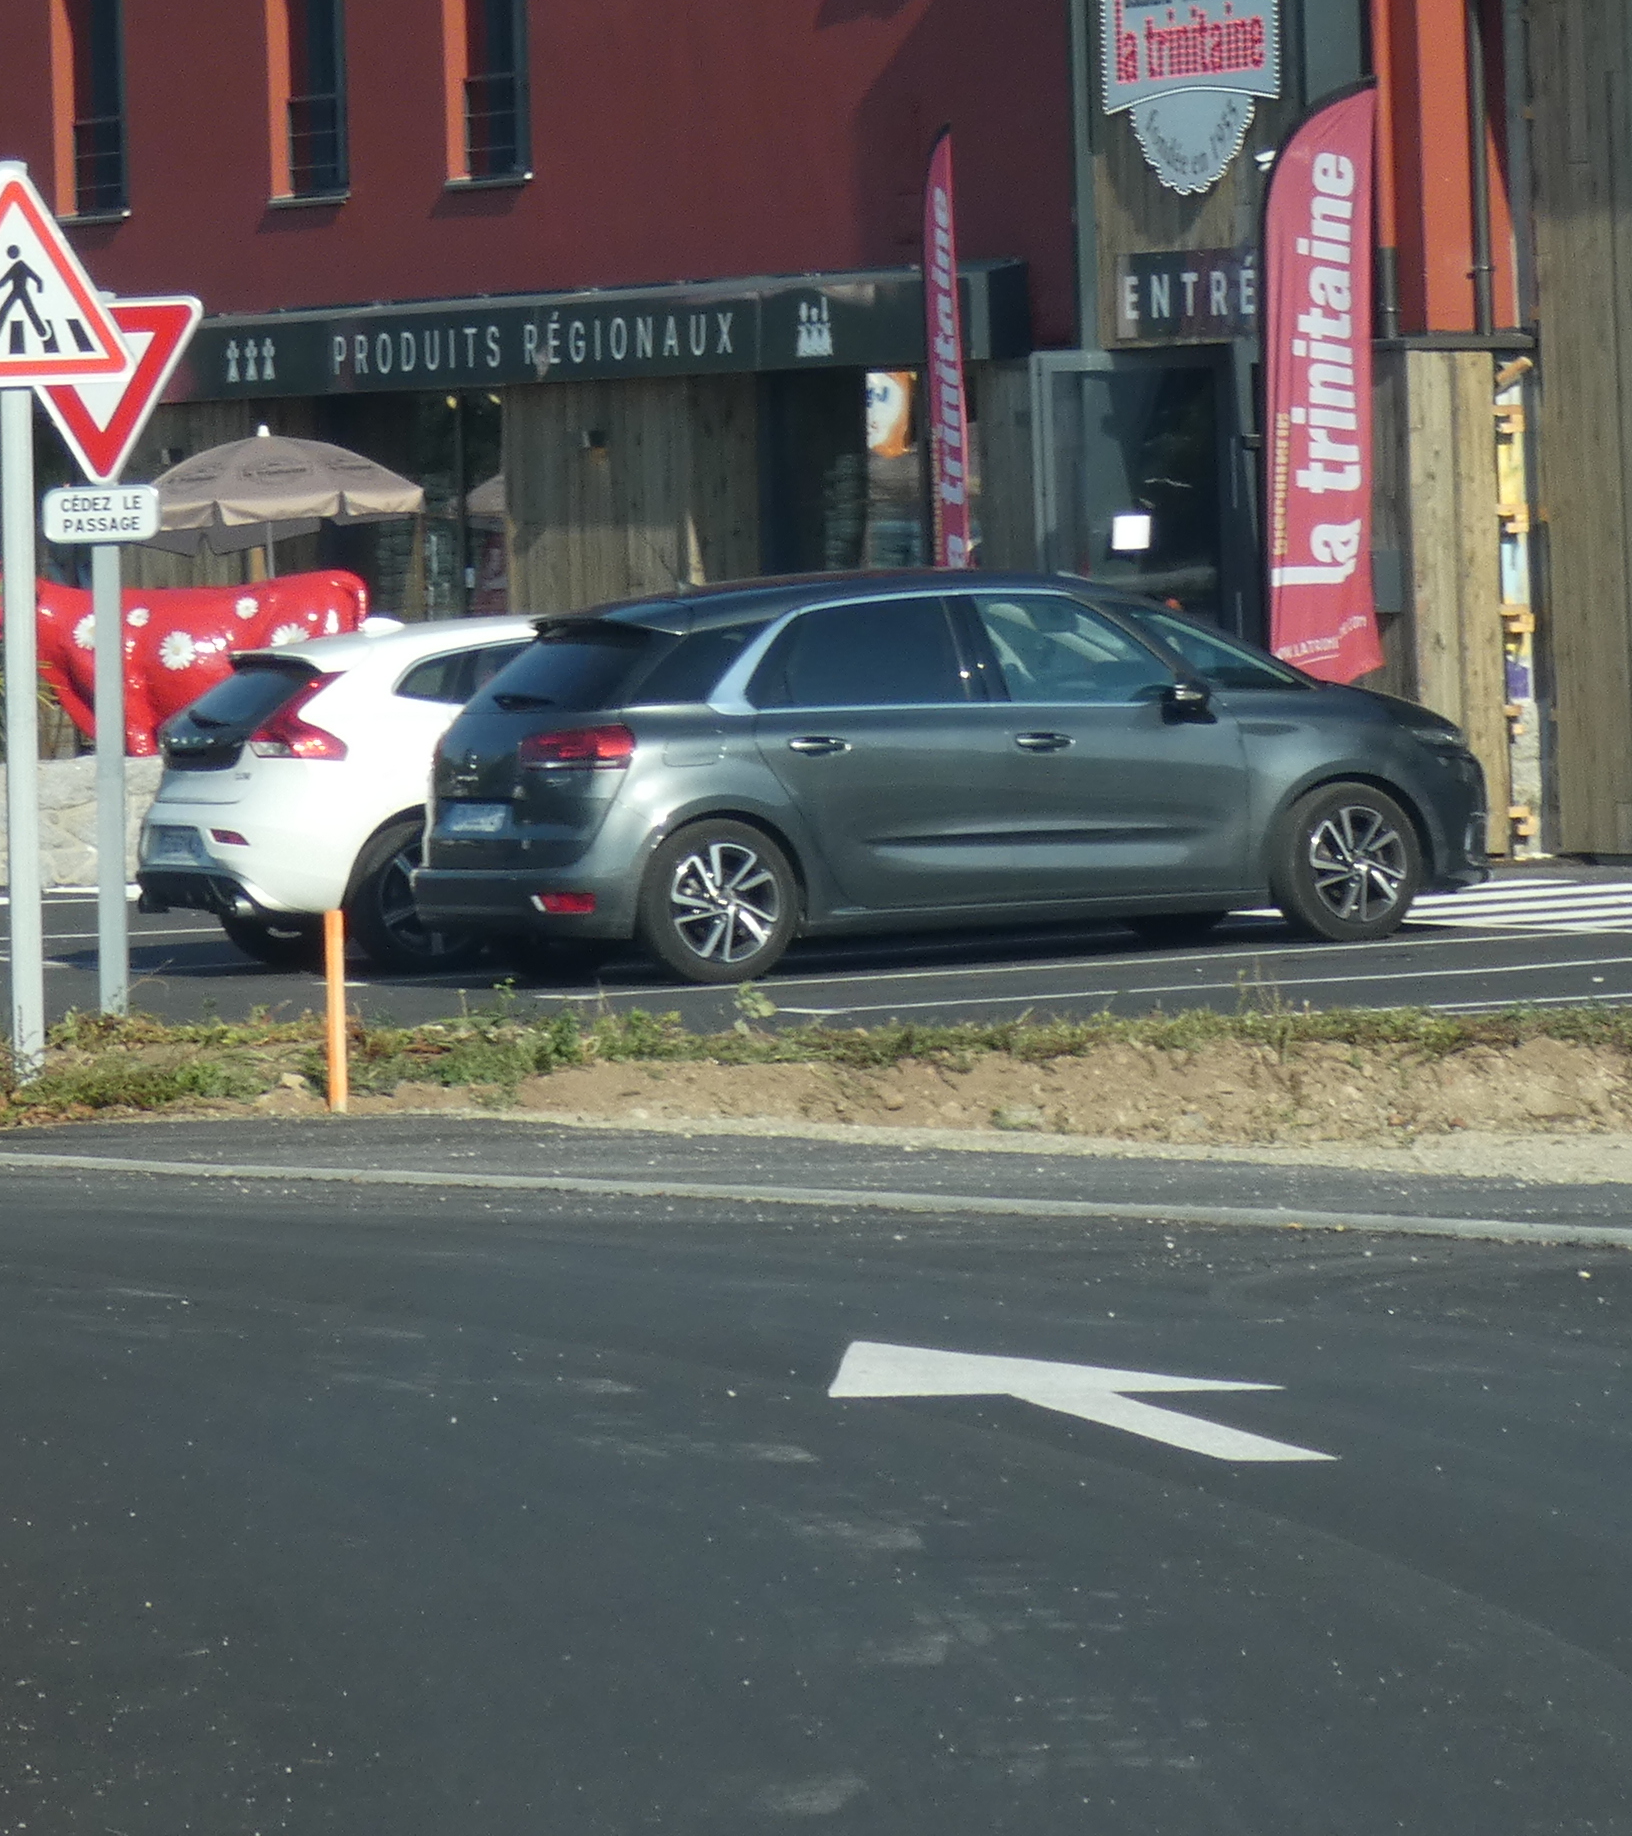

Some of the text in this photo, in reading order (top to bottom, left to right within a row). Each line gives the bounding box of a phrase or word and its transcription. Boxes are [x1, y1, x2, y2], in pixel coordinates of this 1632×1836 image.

[1144, 0, 1265, 81] trinitaine
[1123, 255, 1256, 320] ENTRÉ
[332, 311, 735, 375] PRODUITS RÉGIONAUX
[1290, 152, 1362, 494] trinitaine
[60, 494, 143, 512] CÉDEZ LE
[63, 516, 141, 533] PASSAGE
[1271, 518, 1362, 587] la
